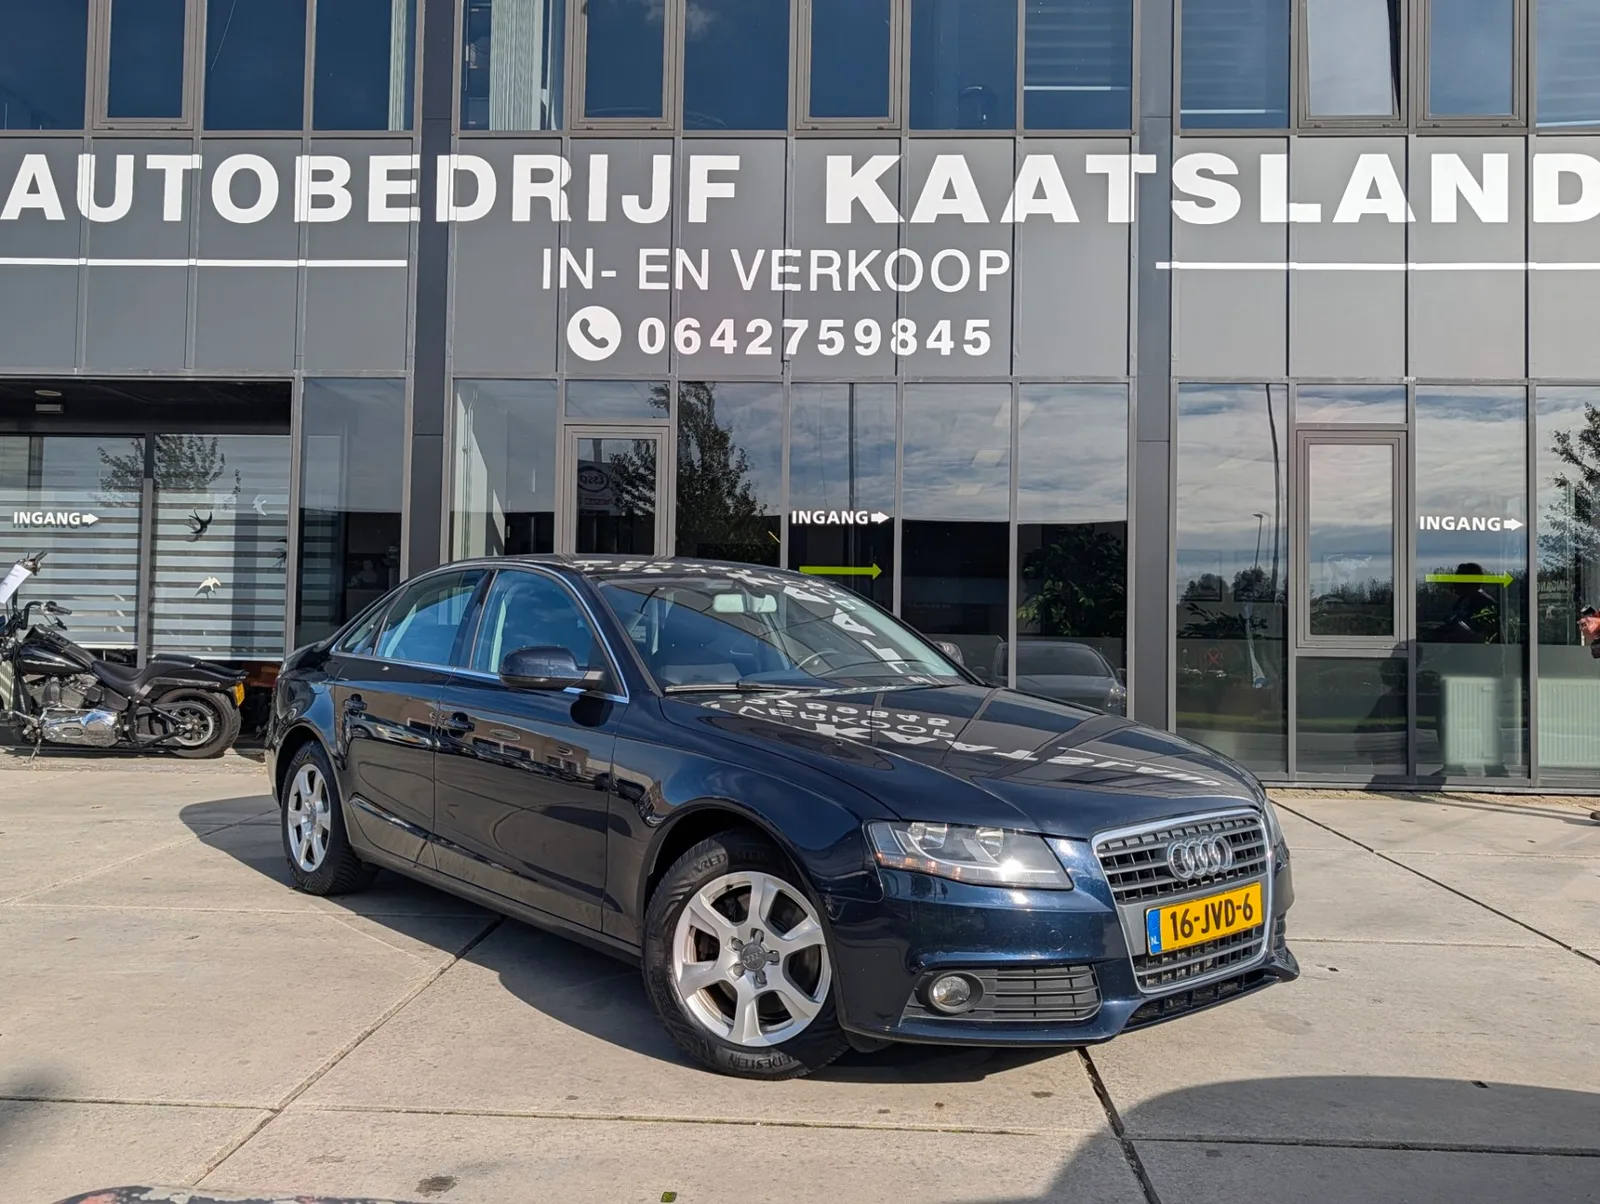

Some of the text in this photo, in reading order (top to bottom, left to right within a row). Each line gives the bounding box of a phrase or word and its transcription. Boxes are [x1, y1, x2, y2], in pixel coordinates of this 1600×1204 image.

[0, 153, 1600, 225] AUTOBEDRIJF KAATSLAND
[542, 247, 1010, 293] IN- EN VERKOOP
[637, 317, 992, 356] 0642759845
[13, 511, 80, 525] INGANG
[791, 510, 868, 525] INGANG
[1419, 516, 1501, 532] INGANG
[1169, 892, 1254, 942] 16-JVD-6
